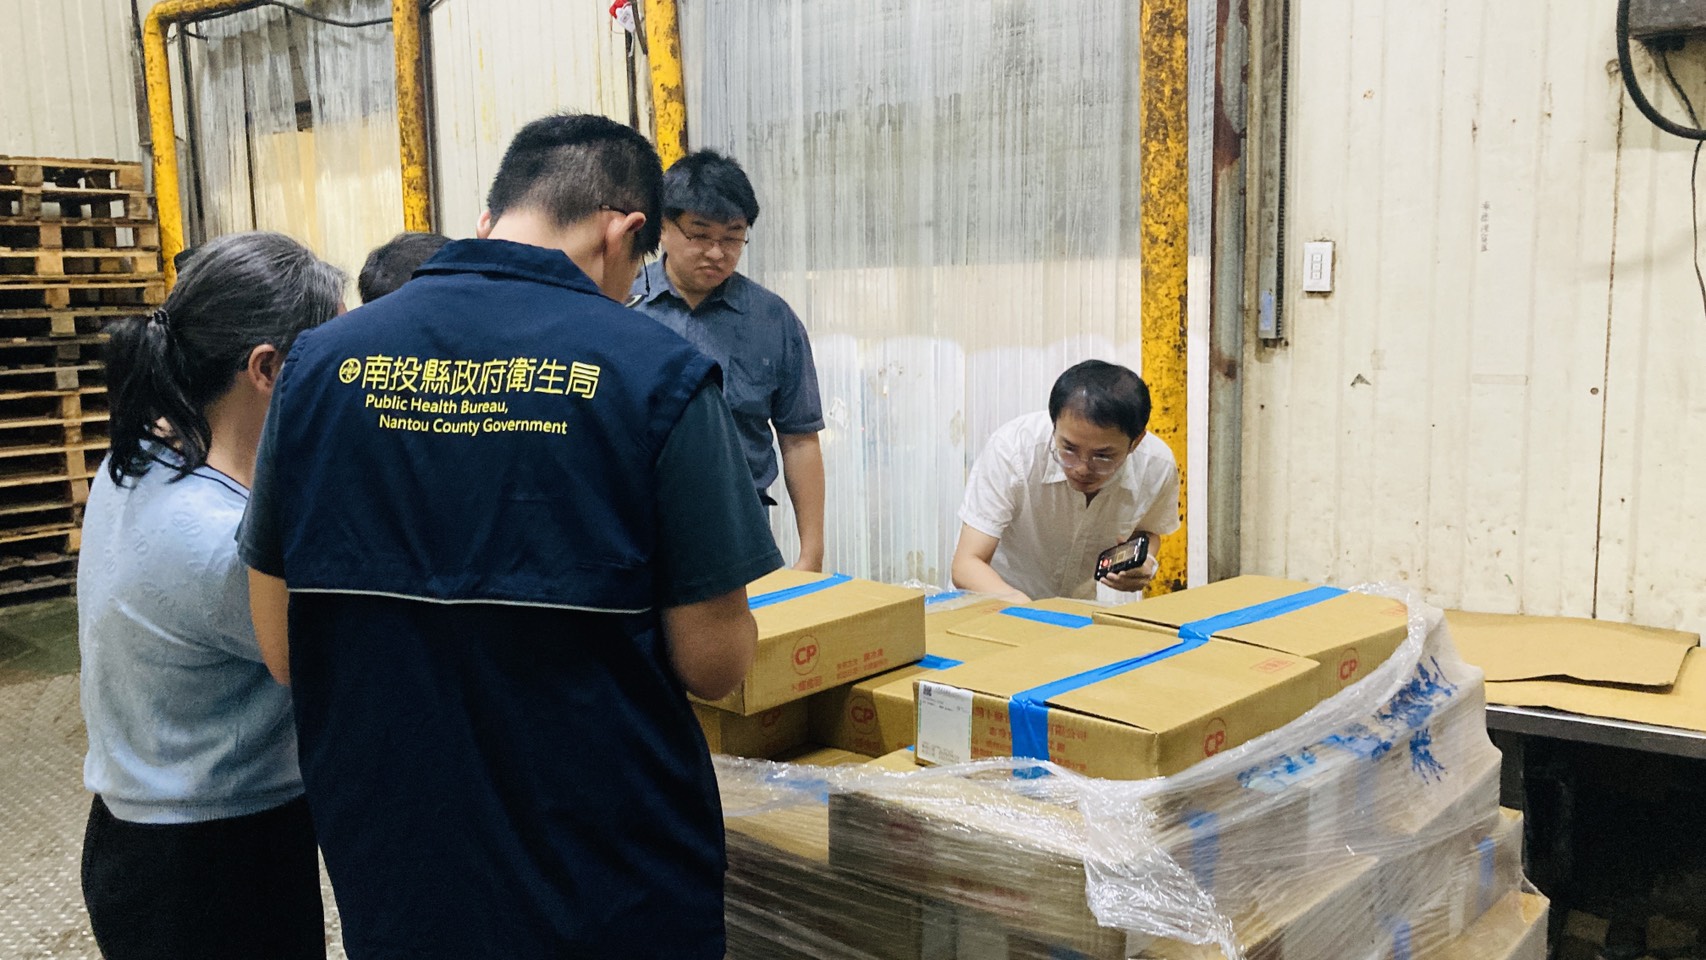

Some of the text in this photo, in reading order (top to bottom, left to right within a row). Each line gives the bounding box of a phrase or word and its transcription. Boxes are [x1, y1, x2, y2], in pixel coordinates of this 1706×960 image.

[361, 353, 601, 399] 南投縣政府衛生局
[365, 394, 509, 414] Public Health Bureau,
[379, 414, 568, 437] Nantou County Government
[795, 644, 817, 666] CP
[1339, 658, 1358, 681] CP
[851, 706, 874, 725] CP
[1204, 730, 1225, 758] CP
